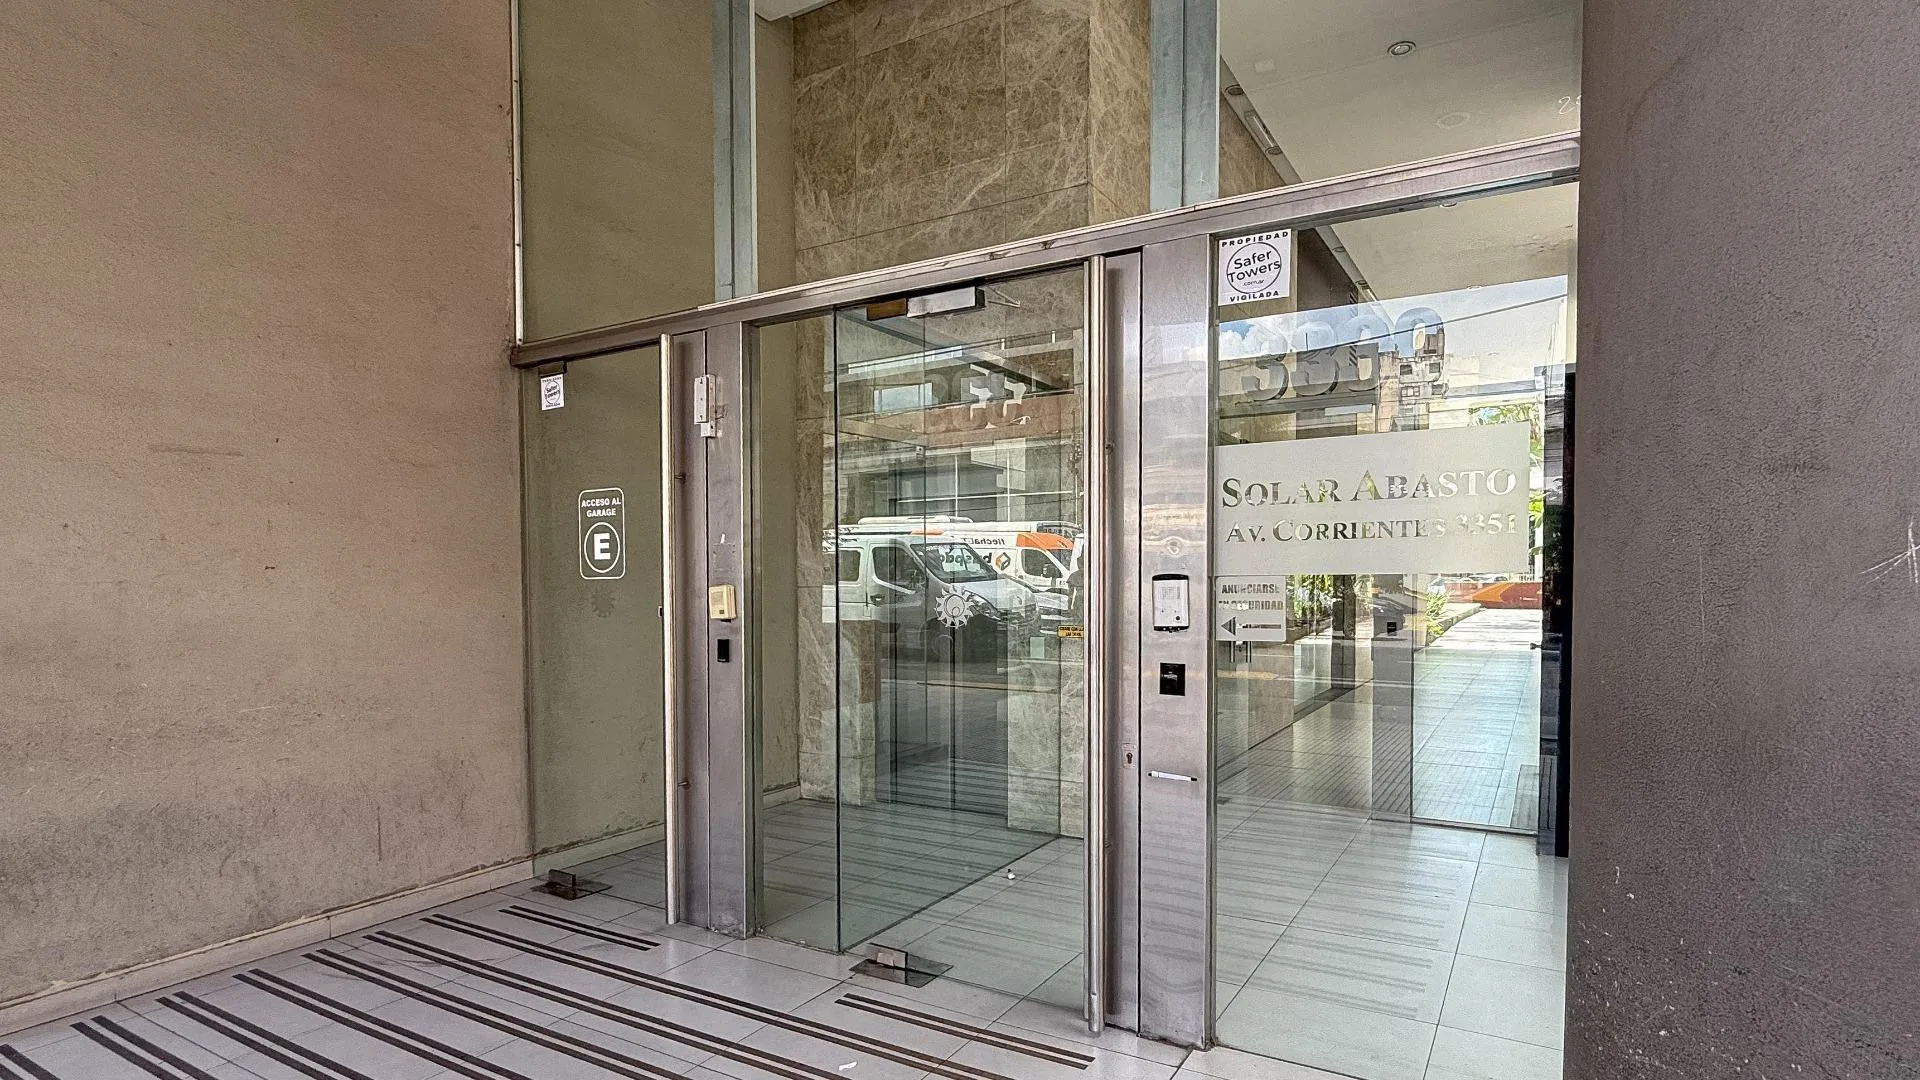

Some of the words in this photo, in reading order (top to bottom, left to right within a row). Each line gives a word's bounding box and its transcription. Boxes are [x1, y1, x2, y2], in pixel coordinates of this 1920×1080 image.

[1221, 231, 1289, 248] PROPIEDAD
[1234, 250, 1272, 270] Safer
[1228, 260, 1281, 283] Towers
[1229, 290, 1279, 303] VIGILADA
[581, 498, 611, 508] ACCESO
[612, 497, 622, 506] AL
[586, 508, 617, 518] GARAGE
[593, 532, 612, 560] E
